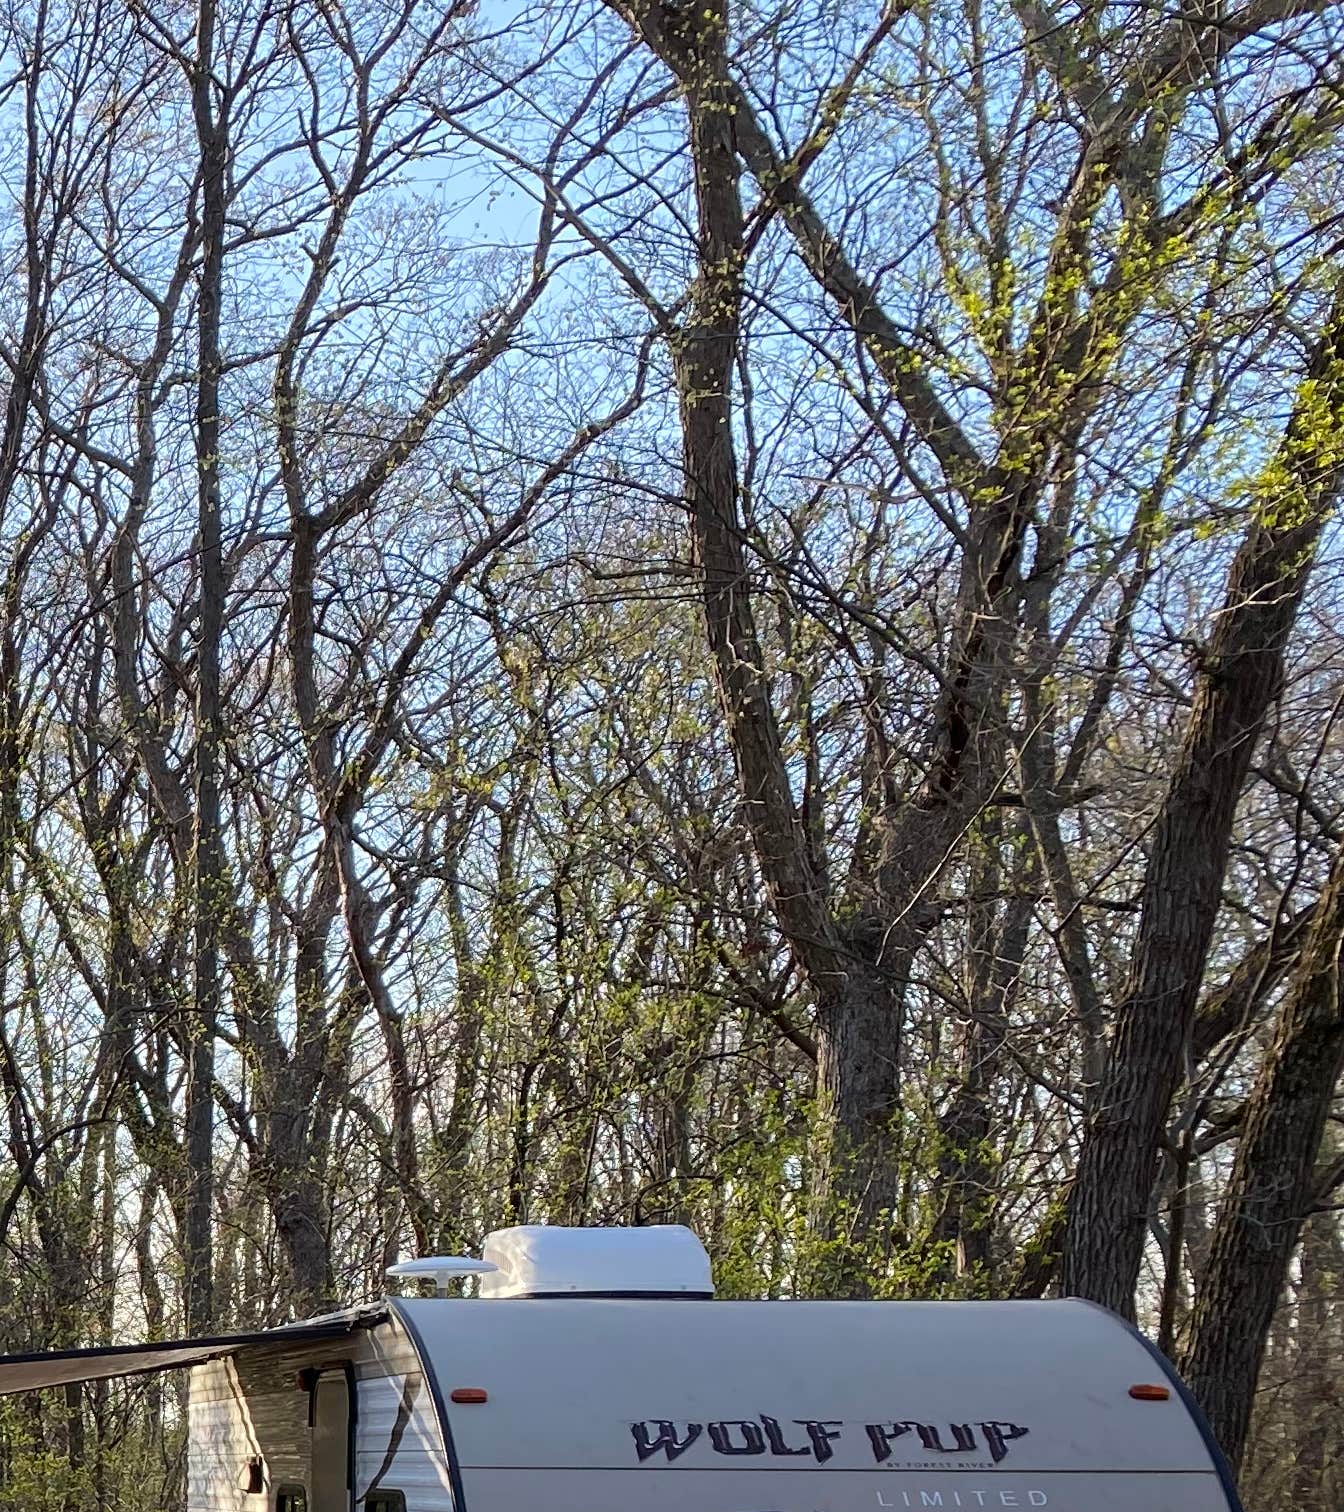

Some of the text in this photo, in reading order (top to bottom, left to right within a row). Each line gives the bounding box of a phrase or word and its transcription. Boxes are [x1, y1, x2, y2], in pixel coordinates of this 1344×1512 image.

[630, 1413, 1030, 1465] WOLF PUP
[876, 1490, 1049, 1508] LIMITED
